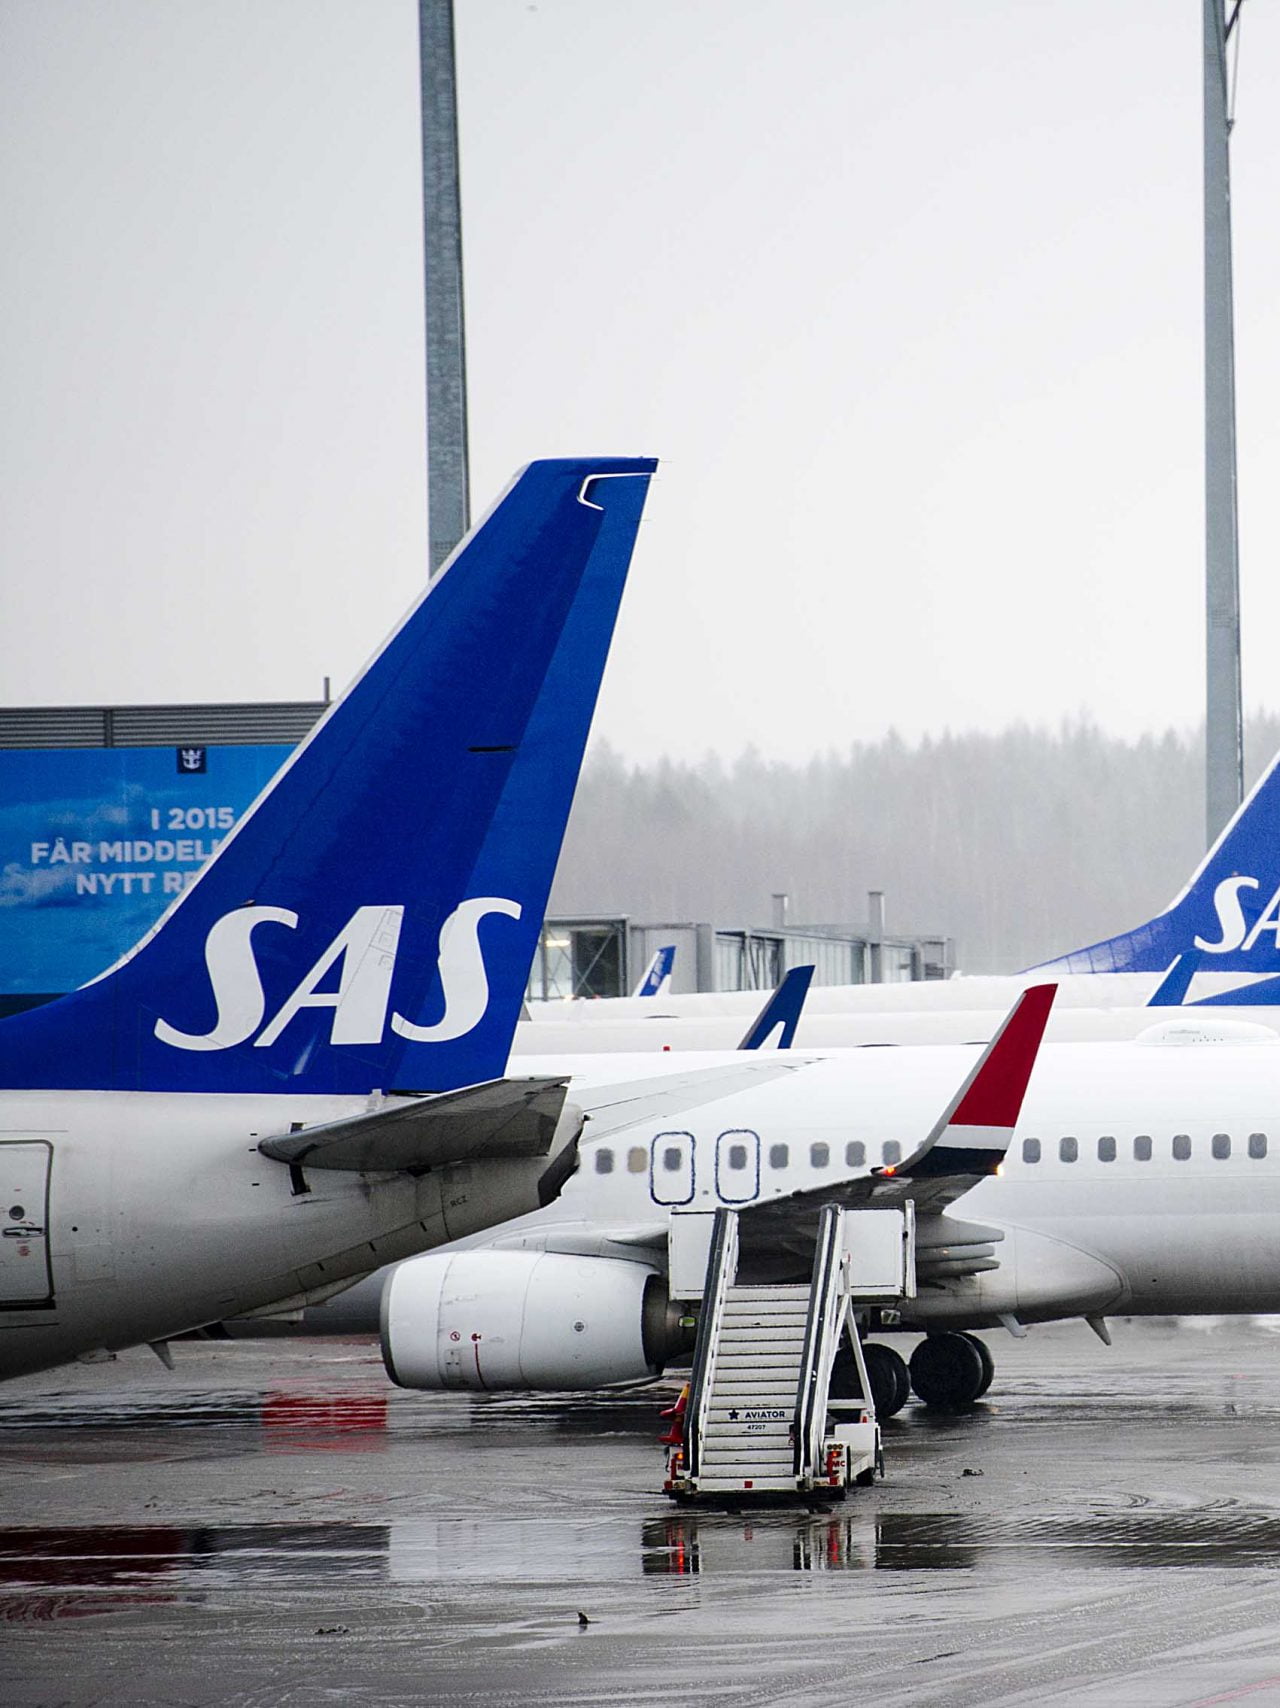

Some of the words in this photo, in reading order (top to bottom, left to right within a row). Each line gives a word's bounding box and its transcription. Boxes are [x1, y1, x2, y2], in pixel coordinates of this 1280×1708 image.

[151, 808, 160, 830] I
[168, 806, 235, 830] 2015
[31, 837, 92, 864] FÅR
[101, 840, 219, 863] MIDDEL
[76, 872, 156, 895] NYTT
[154, 897, 522, 1052] SAS
[745, 1411, 786, 1419] AVIATOR
